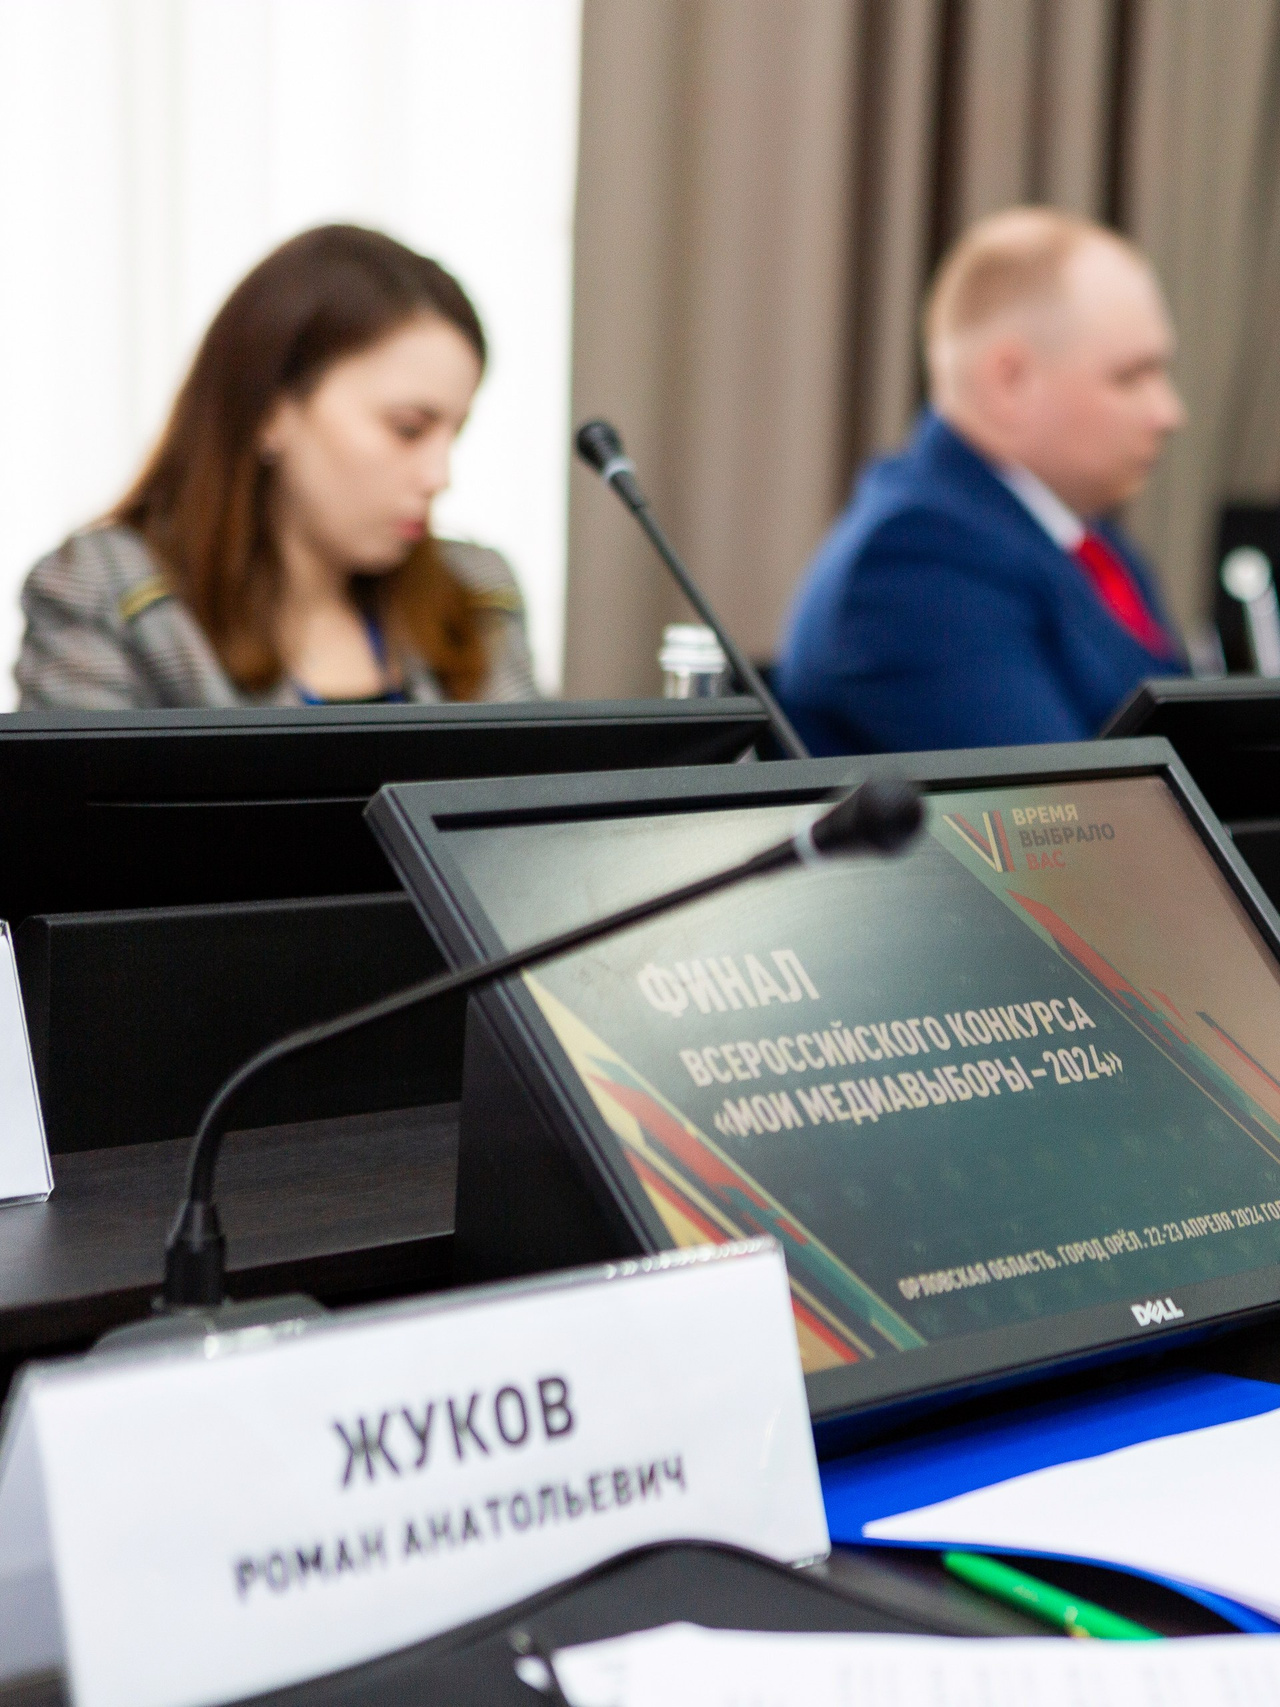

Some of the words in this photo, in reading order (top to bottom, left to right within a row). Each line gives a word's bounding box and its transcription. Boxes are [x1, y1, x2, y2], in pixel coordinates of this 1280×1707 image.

[1011, 803, 1079, 826] ВРЕМЯ
[1018, 822, 1116, 849] ВЫБРАЛО
[1025, 849, 1066, 873] ВАС
[637, 949, 820, 1019] ФИНАЛ
[679, 1016, 951, 1087] ВСЕРОССИЙСКОГО
[944, 996, 1097, 1048] КОНКУРСА
[899, 1261, 992, 1300] ОРЛОВСКАЯ
[1056, 1238, 1109, 1267] ГОРОД
[1147, 1225, 1183, 1248] 22-23
[1183, 1212, 1235, 1240] АПРЕЛЯ
[1235, 1206, 1263, 1229] 2024
[1130, 1297, 1185, 1327] DELL
[330, 1374, 578, 1492] ЖУКОВ
[232, 1530, 389, 1604] РОМАН
[402, 1454, 688, 1557] АНАТОЛЬЕВИЧ
